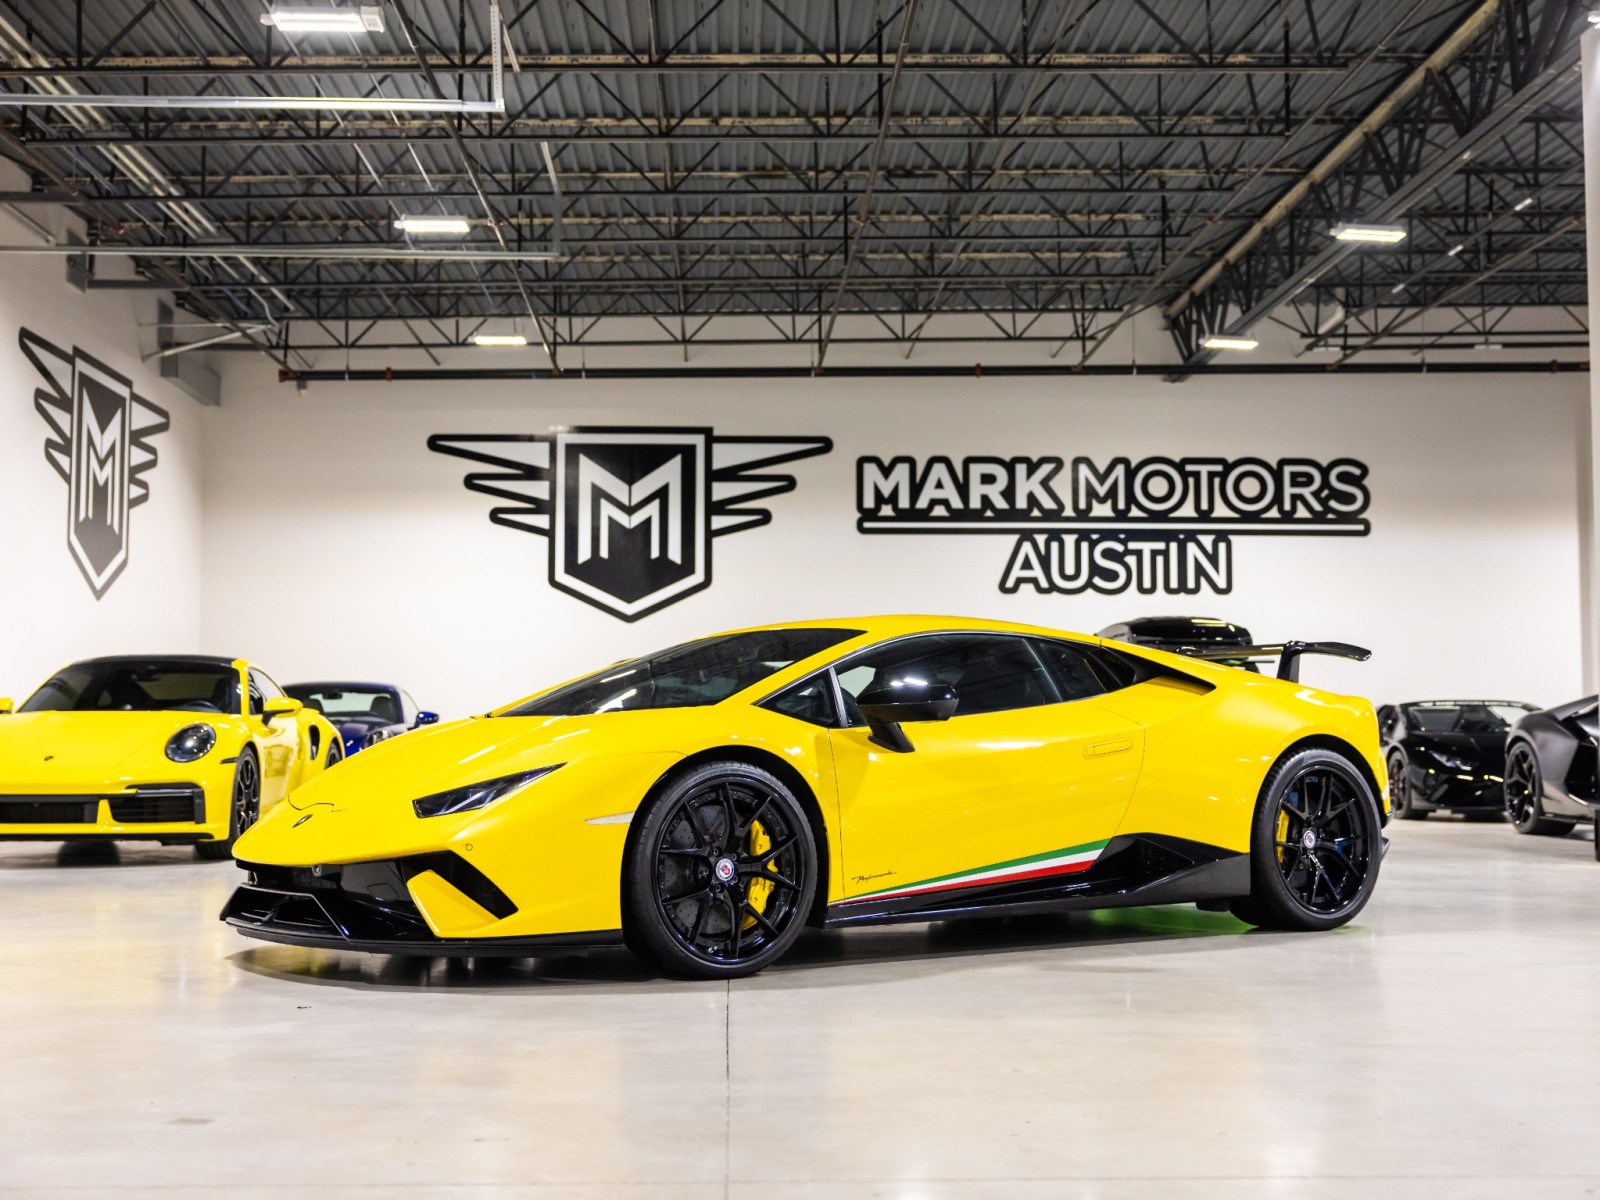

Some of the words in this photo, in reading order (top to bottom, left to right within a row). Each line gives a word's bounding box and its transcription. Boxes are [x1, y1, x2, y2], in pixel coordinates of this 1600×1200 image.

[862, 462, 1059, 510] MARK
[1077, 463, 1365, 513] MOTORS
[1004, 540, 1228, 590] AUSTIN
